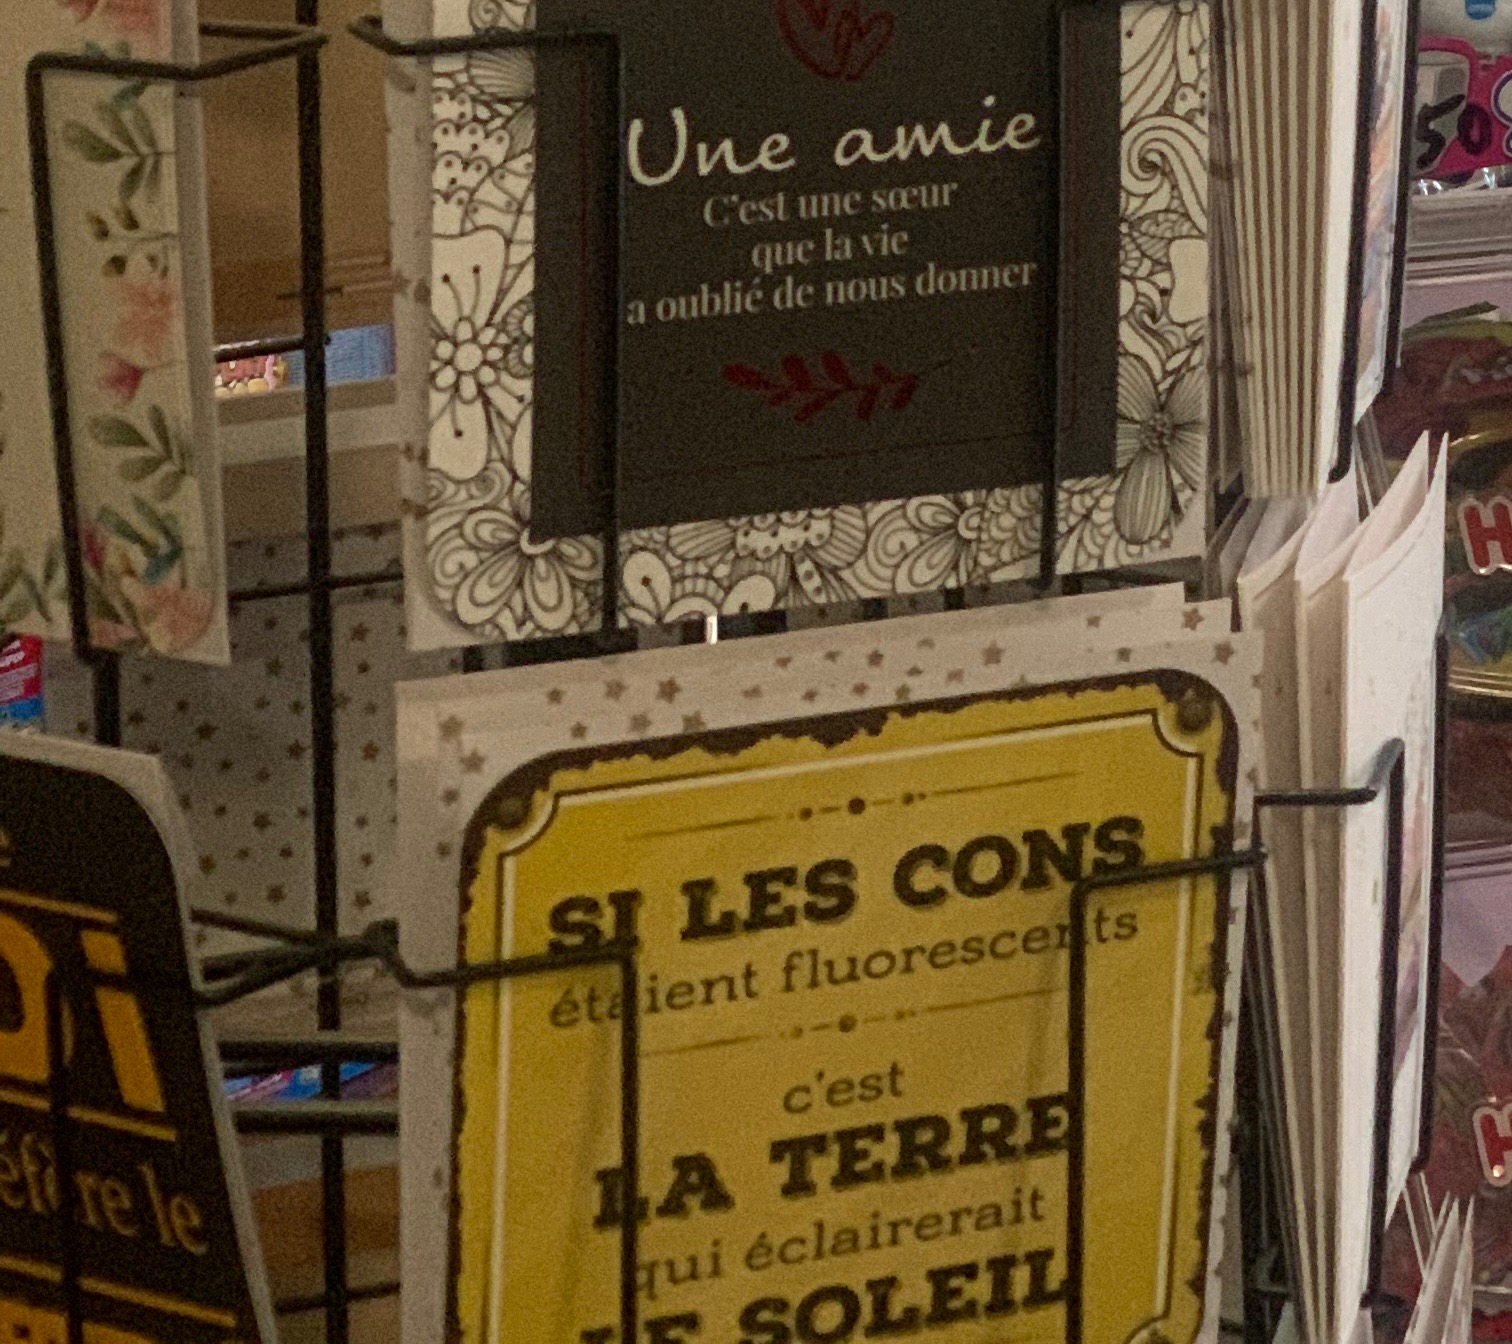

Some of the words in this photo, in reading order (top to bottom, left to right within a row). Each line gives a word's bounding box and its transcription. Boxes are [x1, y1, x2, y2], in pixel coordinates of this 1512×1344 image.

[627, 106, 796, 187] Une
[834, 94, 1042, 168] amie
[750, 239, 815, 275] que
[823, 227, 853, 262] la
[860, 222, 910, 257] vie
[799, 186, 864, 221] une
[627, 296, 647, 326] a
[655, 274, 764, 324] oublié
[773, 273, 815, 310] de
[825, 271, 906, 307] nous
[915, 260, 1038, 297] donner
[546, 888, 643, 958] SI
[680, 857, 857, 942] LES
[891, 815, 1147, 908] CONS
[782, 1060, 905, 1115] c'est
[592, 1153, 735, 1231] LA
[769, 1090, 1074, 1197] TERRE
[633, 1239, 724, 1302] qui
[744, 1184, 1047, 1275] éclairerait
[738, 1246, 1070, 1344] SOLEIL
